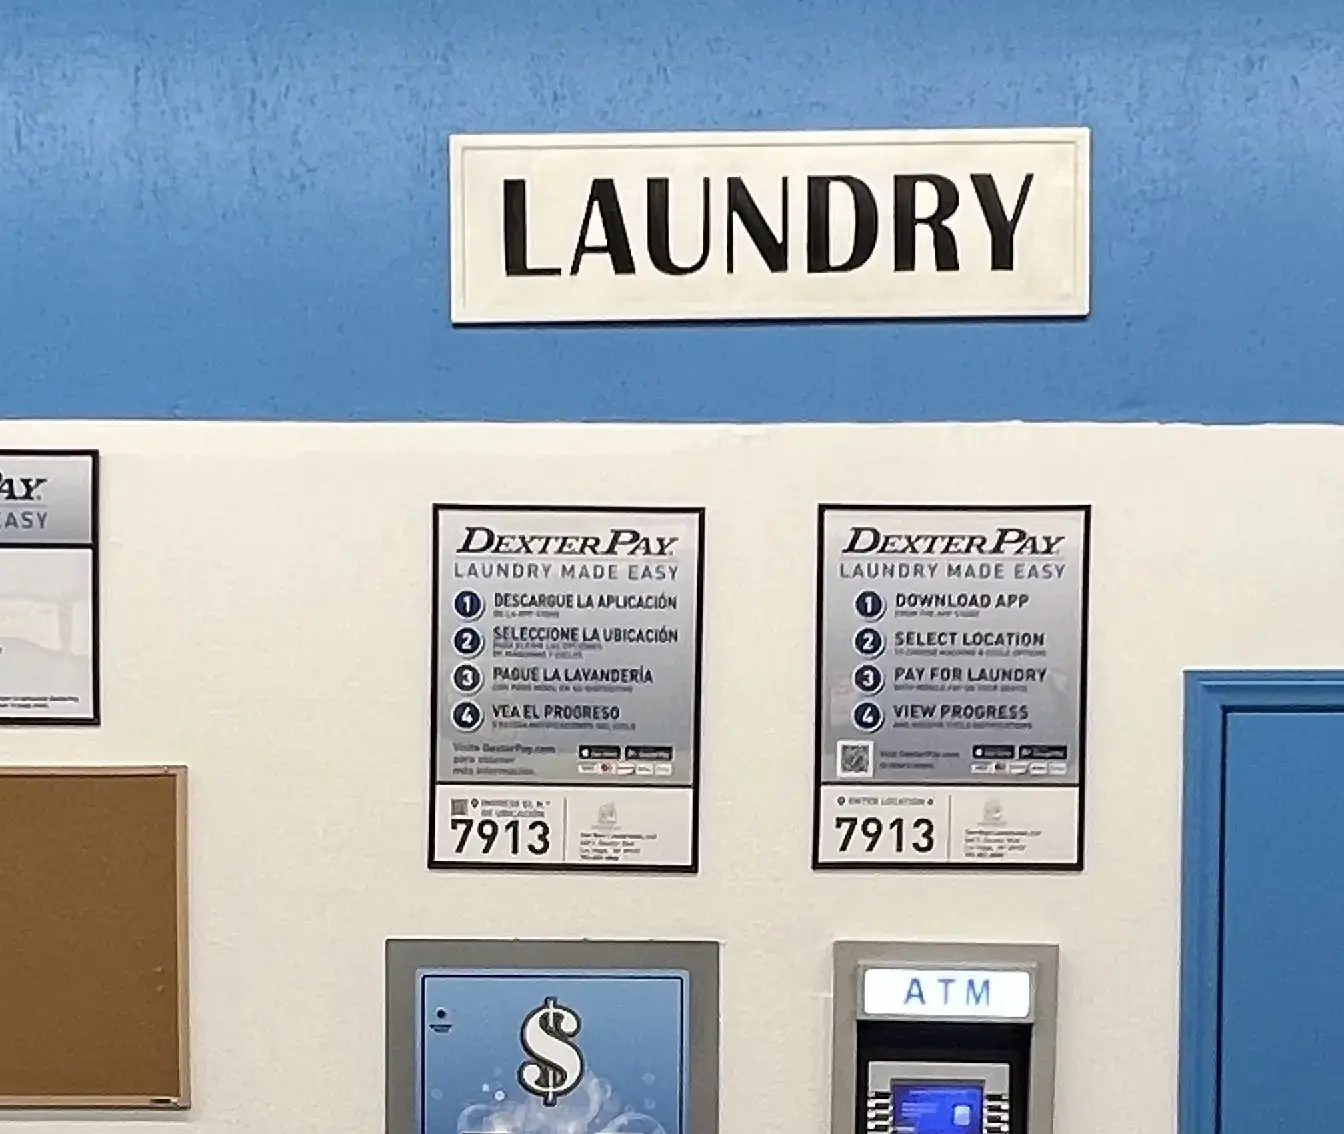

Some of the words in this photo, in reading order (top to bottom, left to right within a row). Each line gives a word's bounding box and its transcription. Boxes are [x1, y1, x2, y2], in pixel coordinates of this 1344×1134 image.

[503, 173, 1034, 277] LAUNDRY
[454, 563, 553, 579] LAUNDRY
[561, 564, 618, 580] MADE
[628, 565, 679, 581] EASY
[840, 563, 938, 579] LAUNDRY
[947, 563, 1004, 579] MADE
[1014, 564, 1066, 580] EASY
[494, 592, 573, 608] DESCARGUE
[577, 594, 594, 608] LA
[598, 591, 677, 609] APLICACIÓN
[896, 593, 991, 608] DOWNLOAD
[995, 594, 1029, 608] APP
[493, 627, 579, 642] SELECCIONE
[582, 627, 600, 642] LA
[603, 625, 678, 643] UBICACIÓN
[895, 631, 958, 646] SELECT
[962, 632, 1044, 646] LOCATION
[493, 666, 539, 682] PAGUE
[543, 668, 561, 682] LA
[564, 665, 653, 683] LAVANDERÍA
[894, 667, 925, 682] PAY
[930, 667, 962, 682] FOR
[967, 667, 1047, 683] LAUNDRY
[492, 704, 519, 718] VEA
[523, 705, 539, 719] EL
[544, 705, 620, 720] PROGRESO
[893, 704, 937, 718] VIEW
[940, 704, 1029, 720] PROGRESS
[451, 819, 549, 855] 7913
[835, 817, 934, 853] 7913
[904, 978, 990, 1005] ATM
